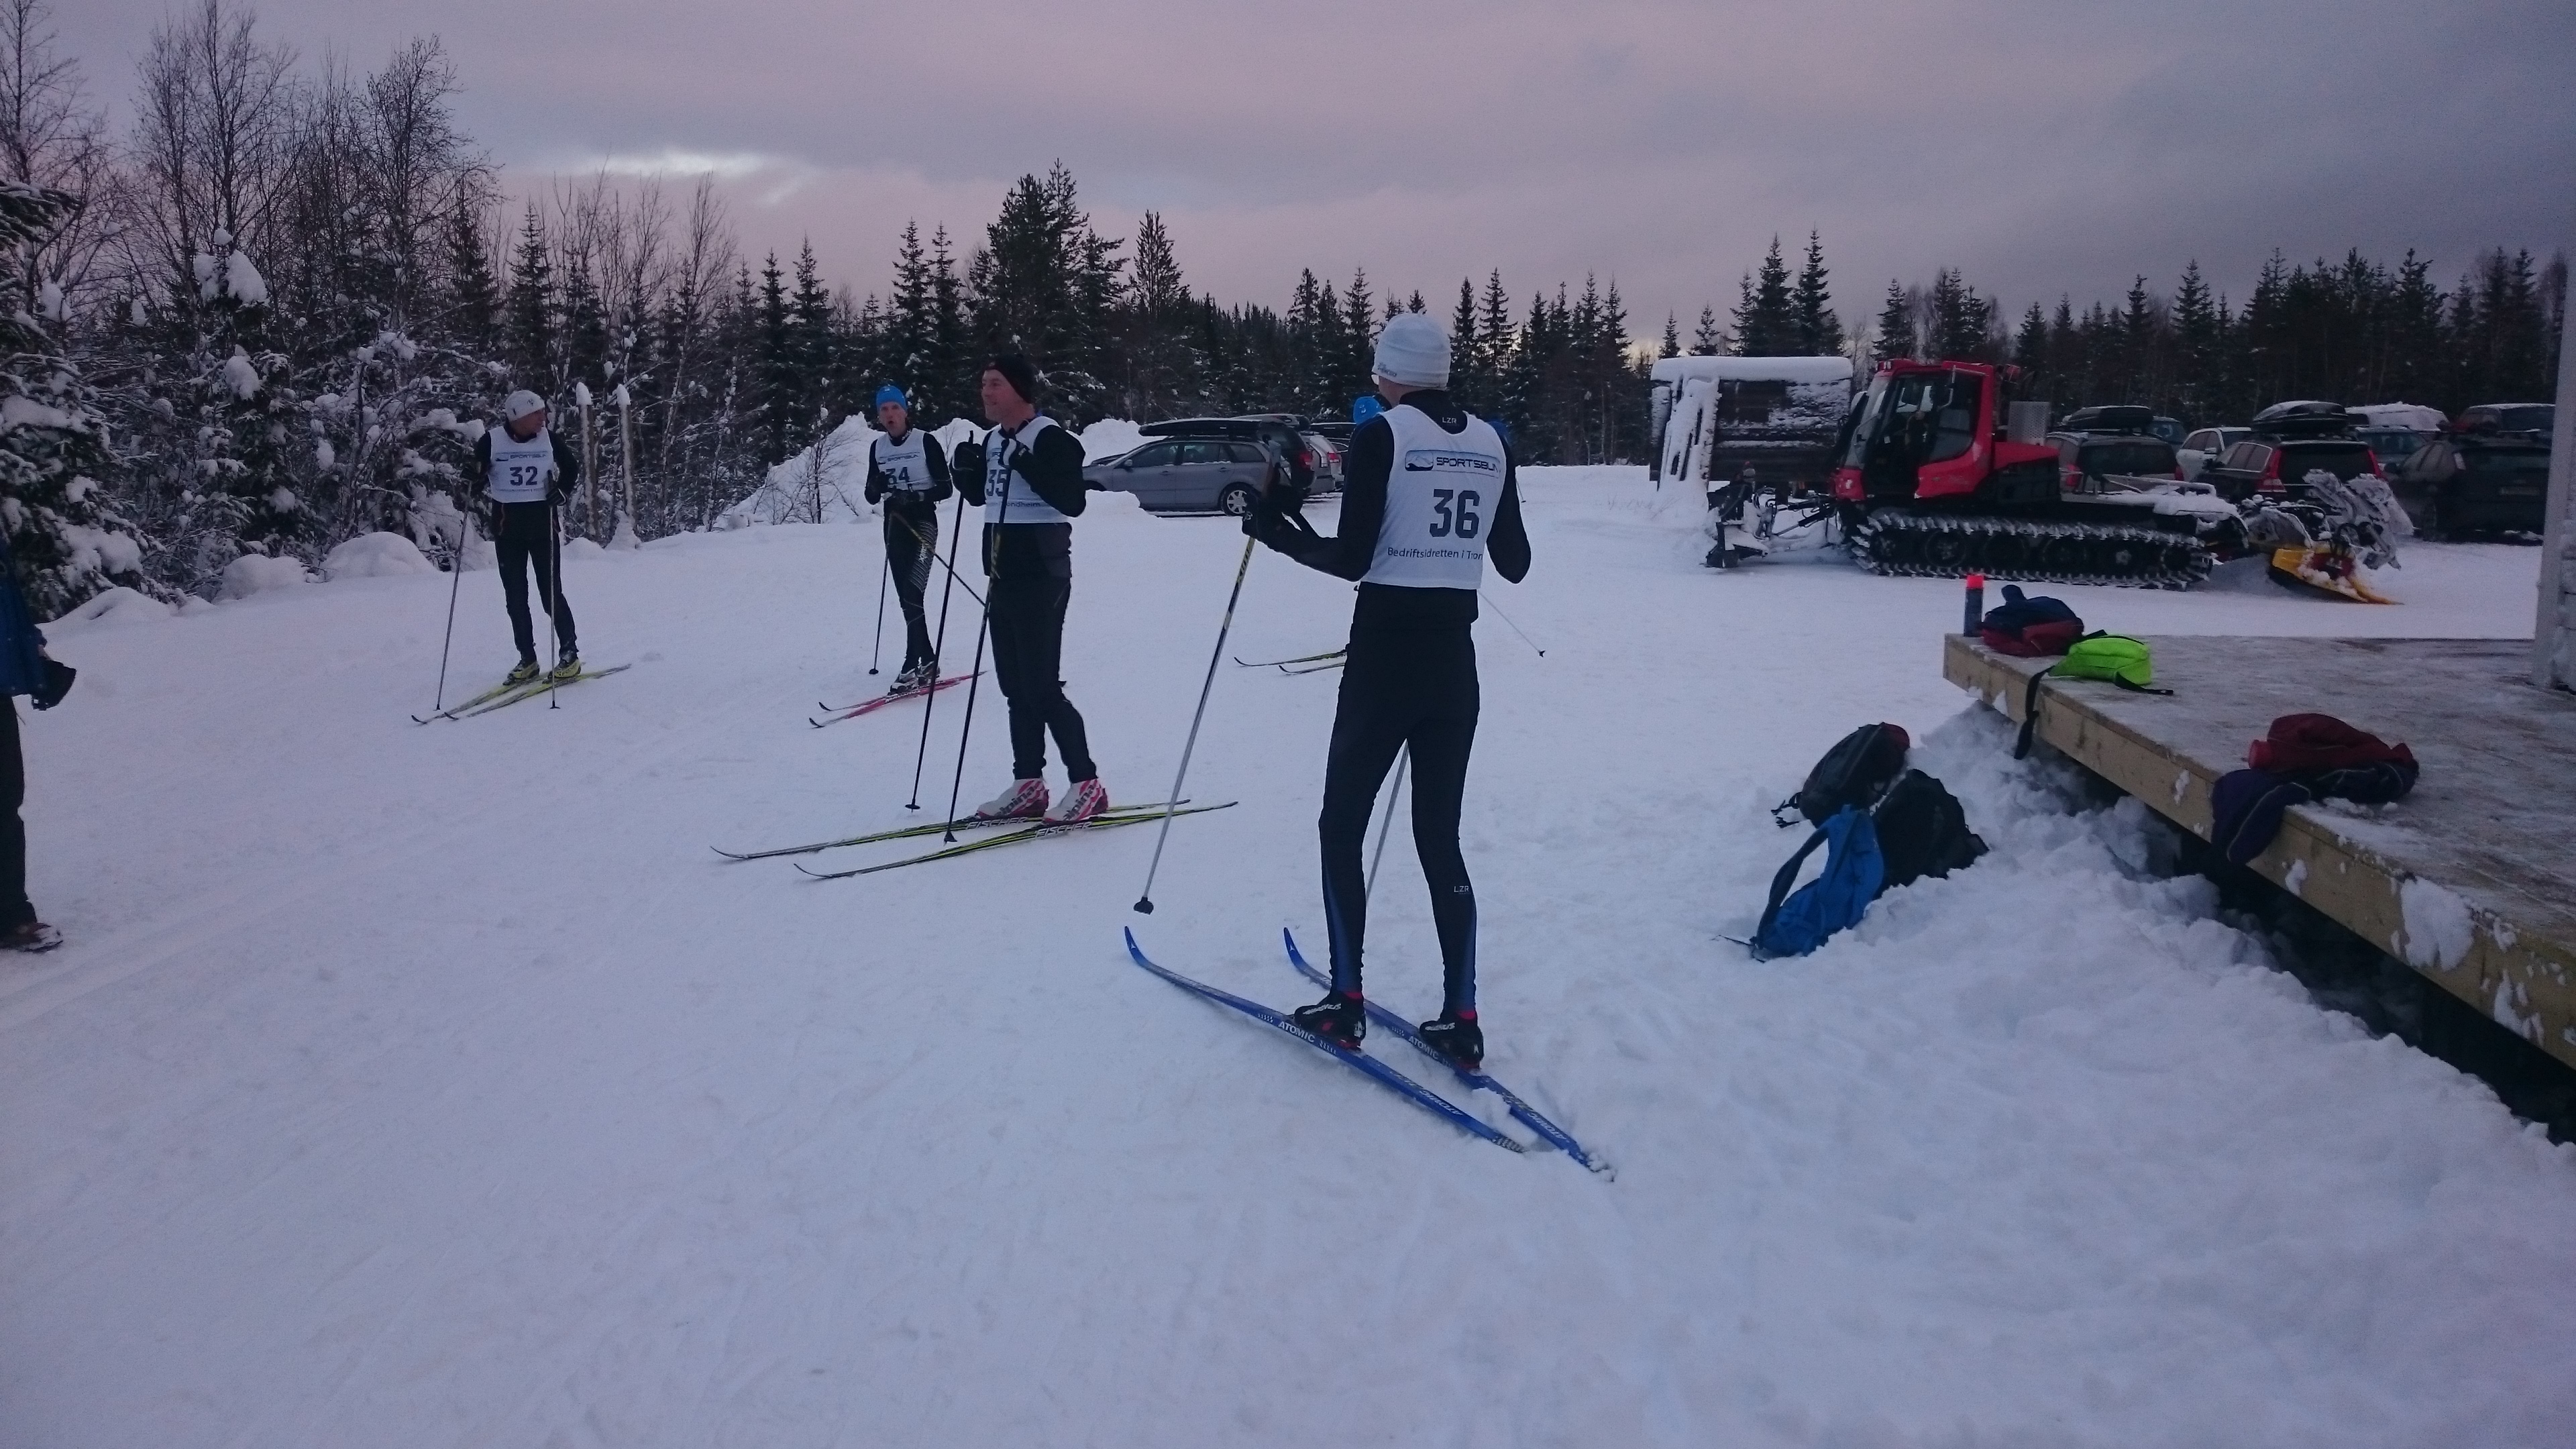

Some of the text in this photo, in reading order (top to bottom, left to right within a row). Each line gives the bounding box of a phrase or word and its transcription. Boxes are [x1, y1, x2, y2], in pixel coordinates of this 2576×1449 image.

[510, 466, 537, 486] 32
[885, 466, 910, 485] 34
[986, 470, 1007, 496] 35
[1429, 489, 1481, 539] 36
[1387, 547, 1459, 558] Bedriftsidretten
[1461, 550, 1464, 558] i
[965, 816, 1028, 830] FISCHER
[1034, 821, 1093, 838] FISCHER
[1278, 1021, 1316, 1043] ATOMIC
[1409, 1036, 1439, 1059] ATOMIC
